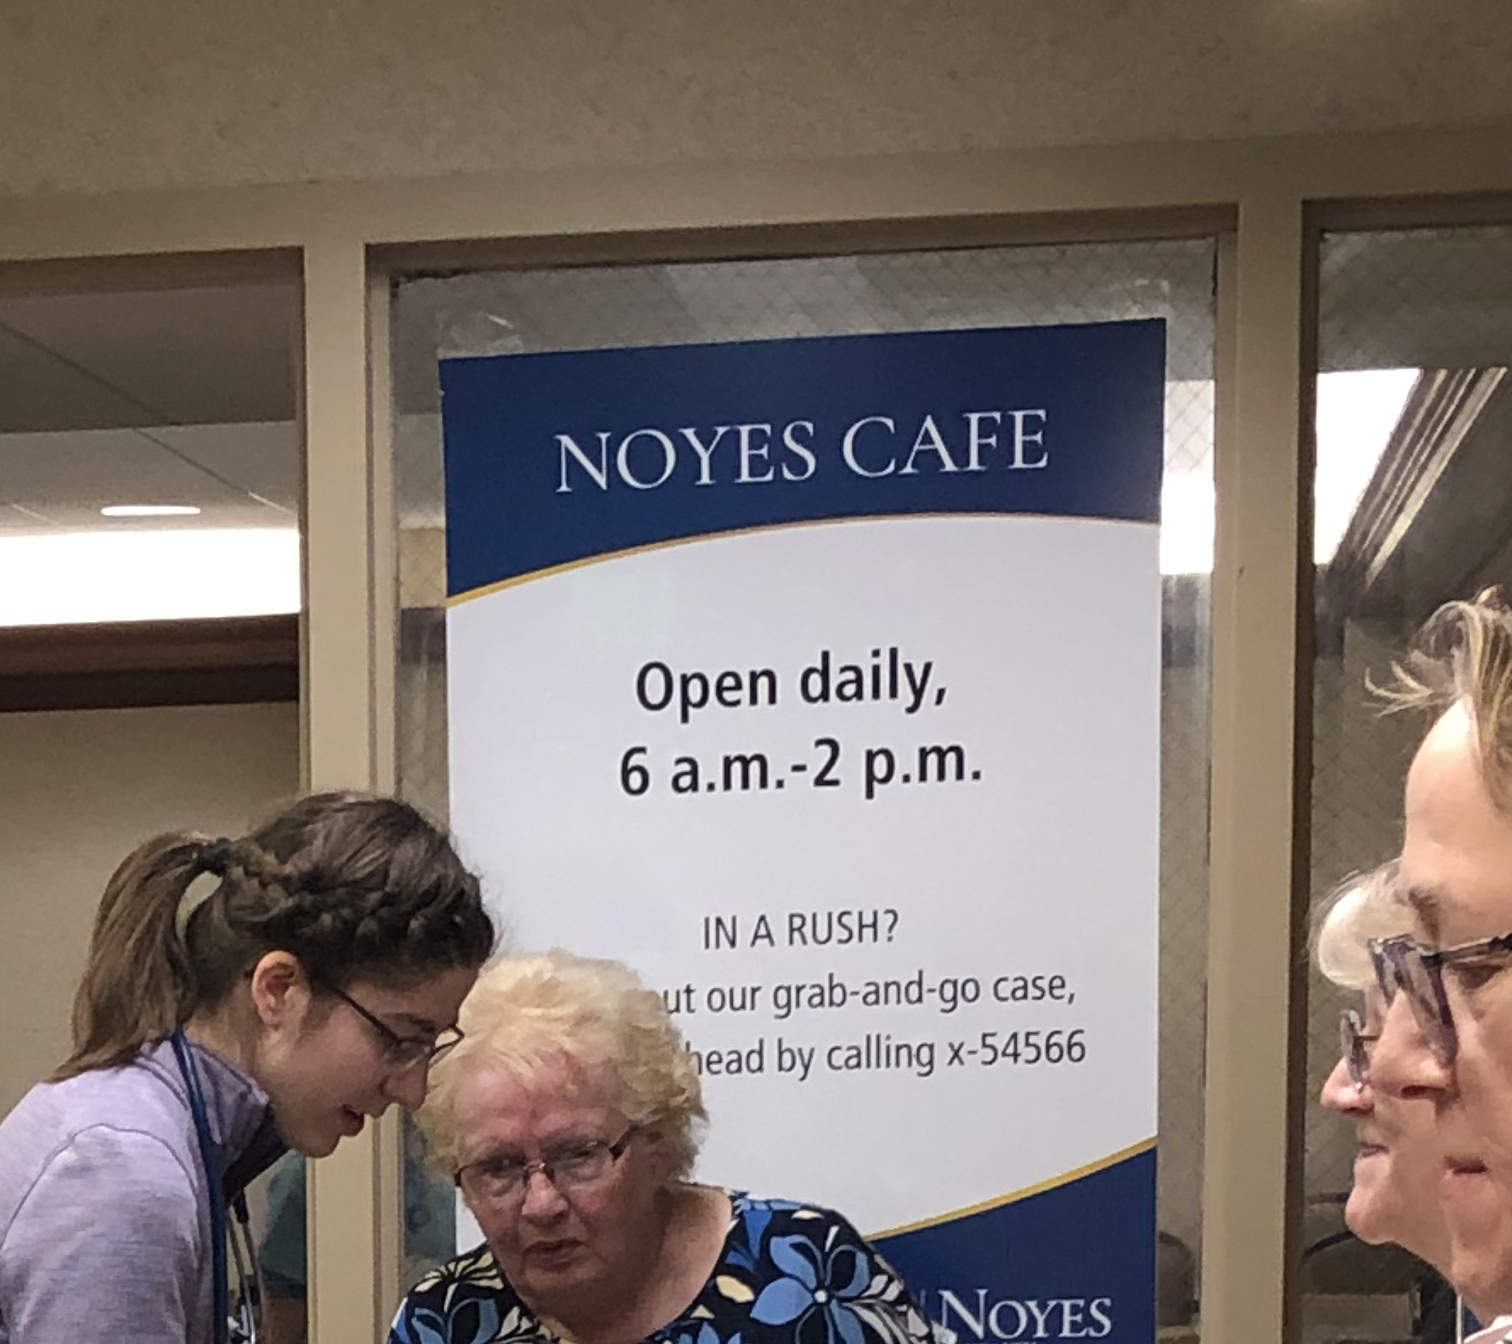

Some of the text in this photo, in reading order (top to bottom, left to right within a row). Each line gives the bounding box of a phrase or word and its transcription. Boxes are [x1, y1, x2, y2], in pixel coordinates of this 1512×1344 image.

[553, 408, 1049, 493] NOYES CAFE
[635, 646, 947, 724] Open daily,
[620, 737, 982, 800] 6 a.m.-2 p.m.
[703, 909, 900, 949] IN A RUSH?
[663, 969, 1076, 1020] ut our grab-and-go case,
[685, 1029, 1088, 1082] head by calling x-54566
